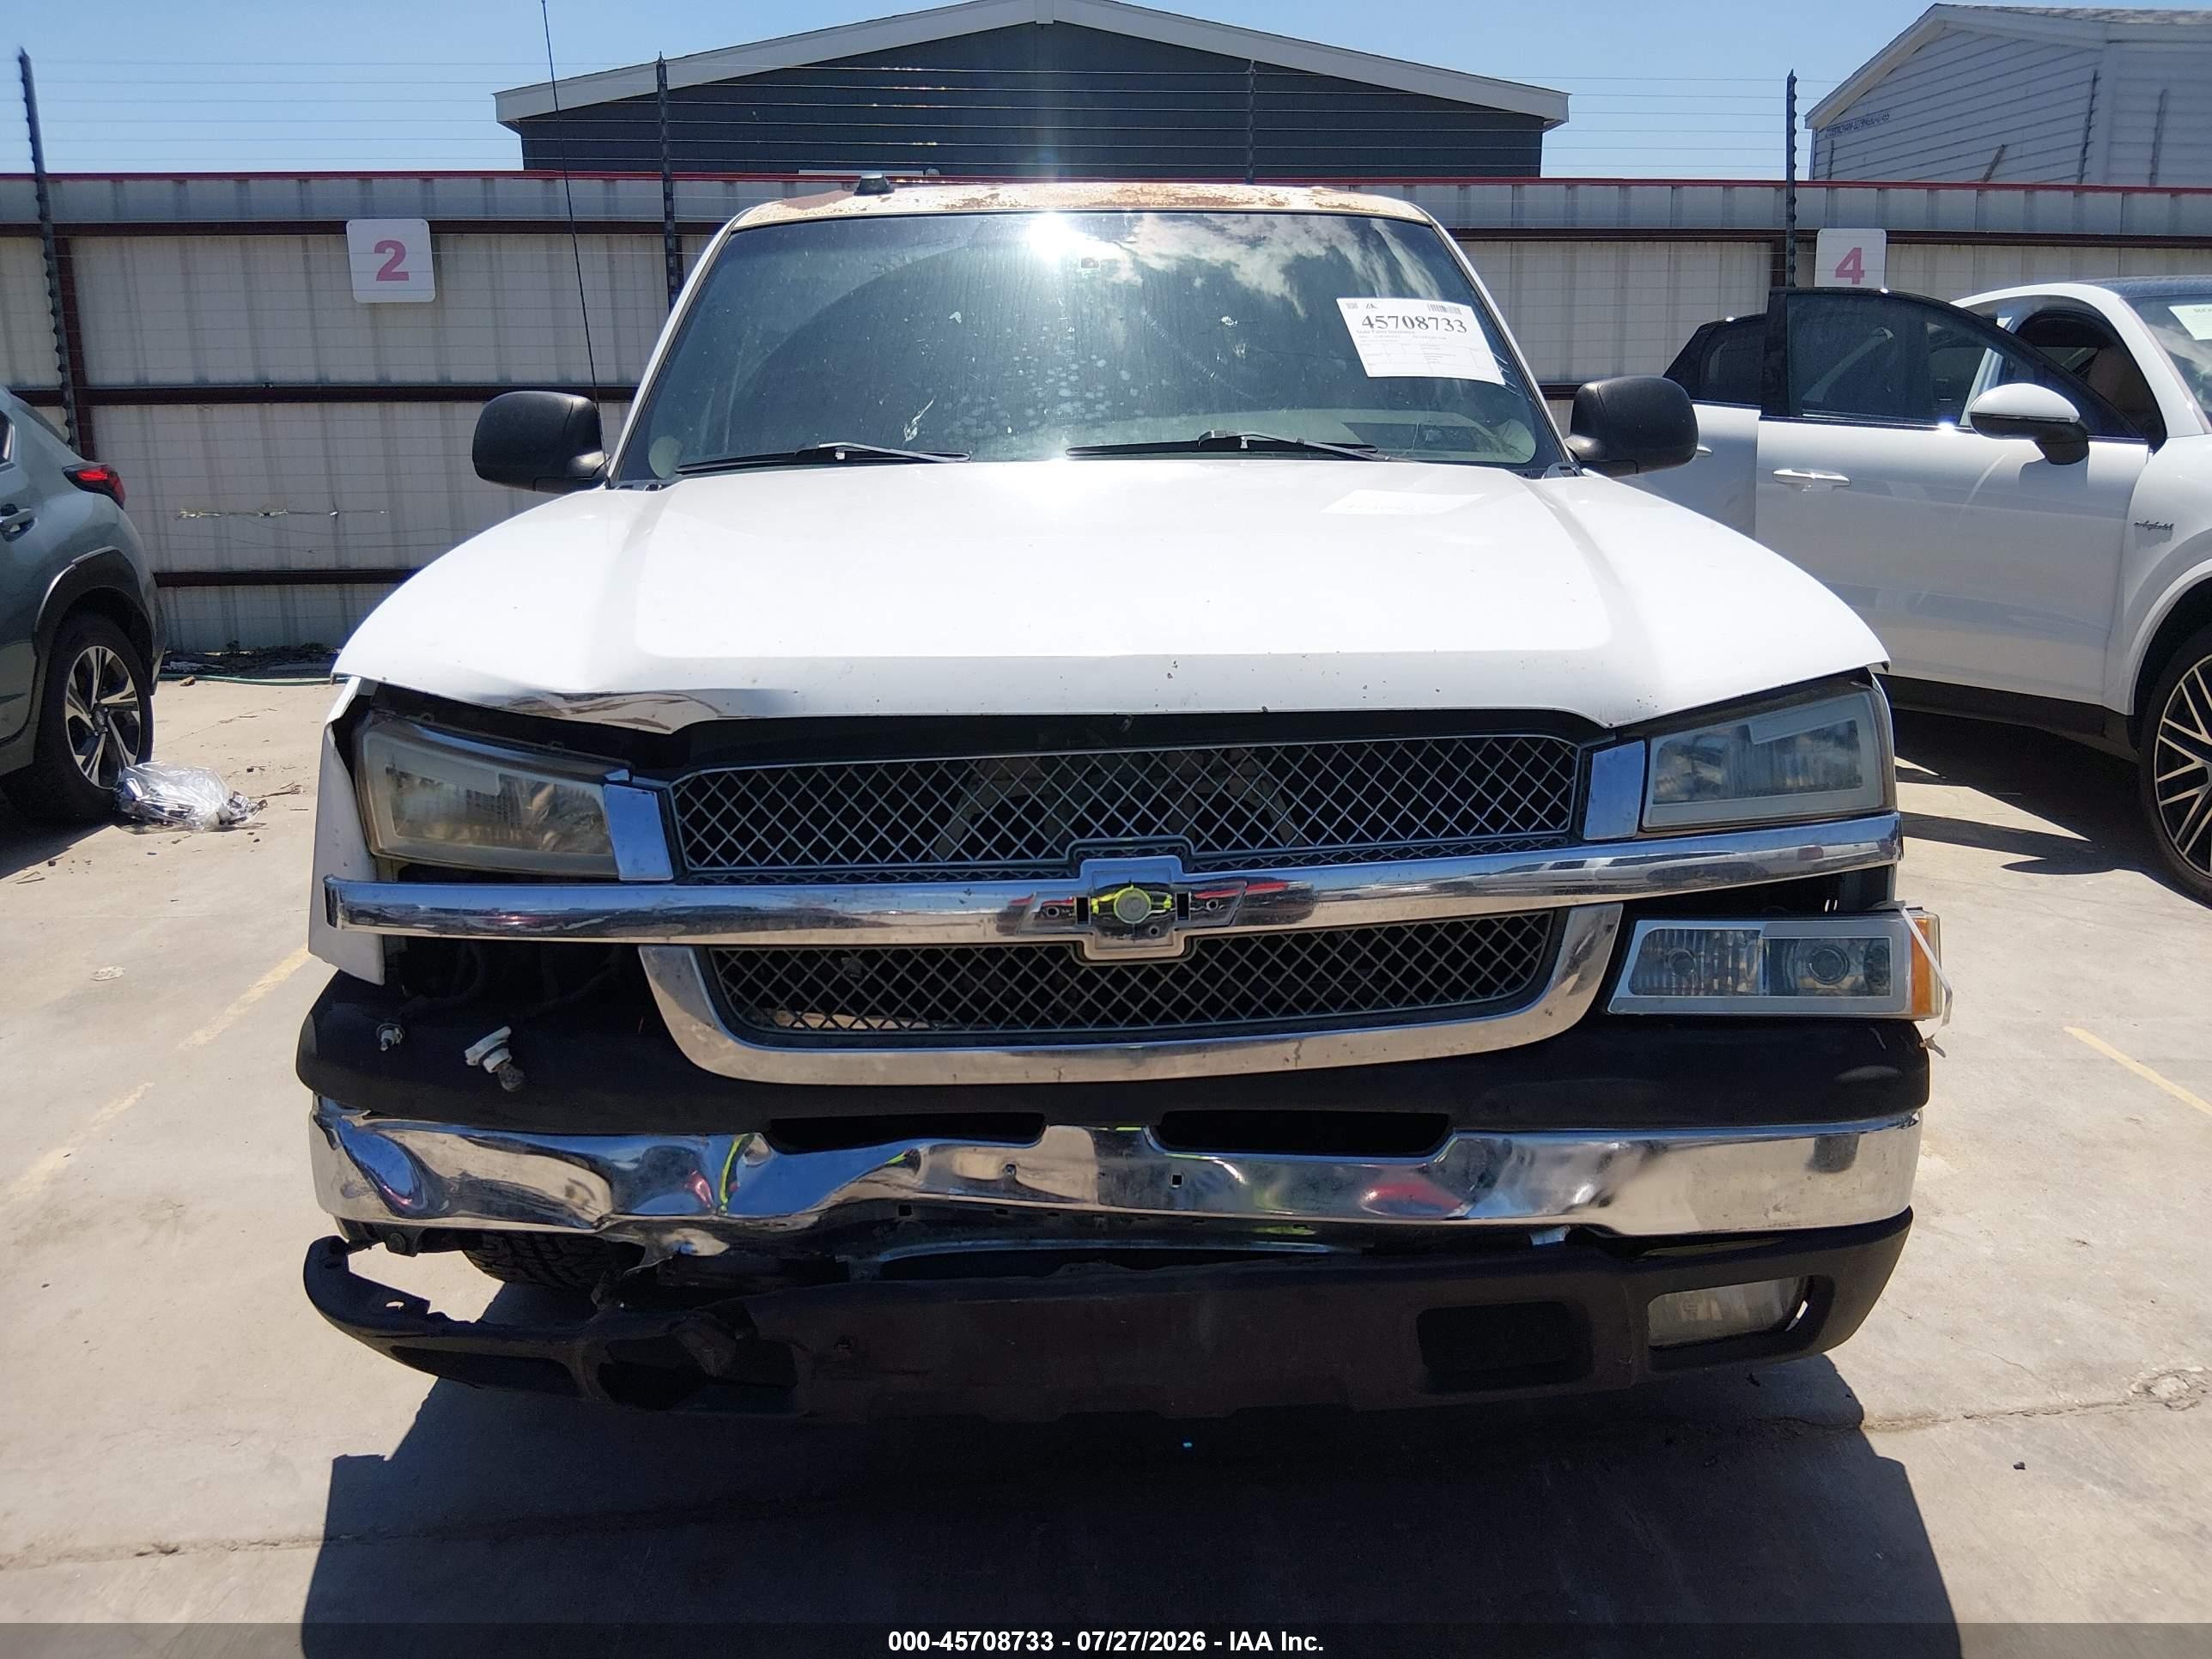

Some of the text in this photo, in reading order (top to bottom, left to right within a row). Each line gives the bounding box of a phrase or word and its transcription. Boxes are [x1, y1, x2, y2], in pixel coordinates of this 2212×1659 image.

[374, 240, 410, 282] 2
[1834, 246, 1865, 285] 4
[1361, 314, 1468, 334] 45708733
